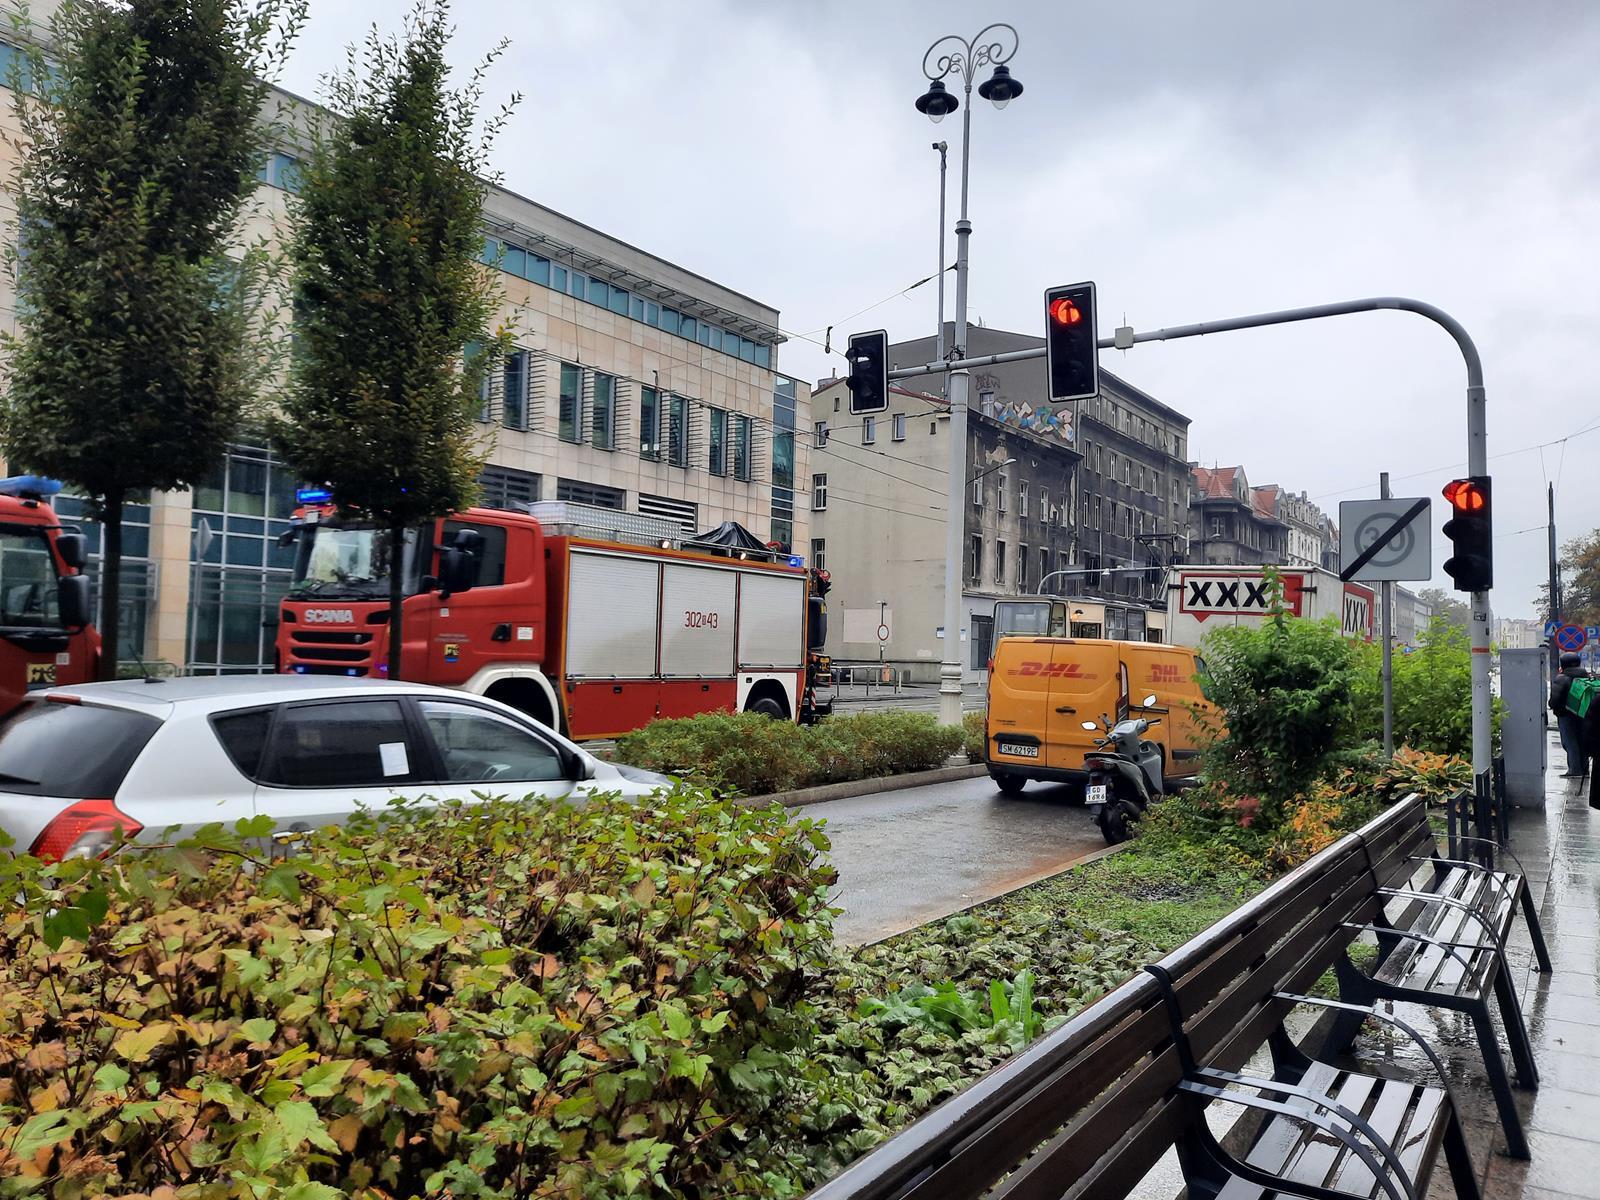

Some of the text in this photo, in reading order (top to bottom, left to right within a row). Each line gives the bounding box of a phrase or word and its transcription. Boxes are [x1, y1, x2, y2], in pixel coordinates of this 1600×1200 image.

[304, 609, 354, 623] SCANIA
[1019, 661, 1084, 679] DHL
[1151, 663, 1181, 683] DHL
